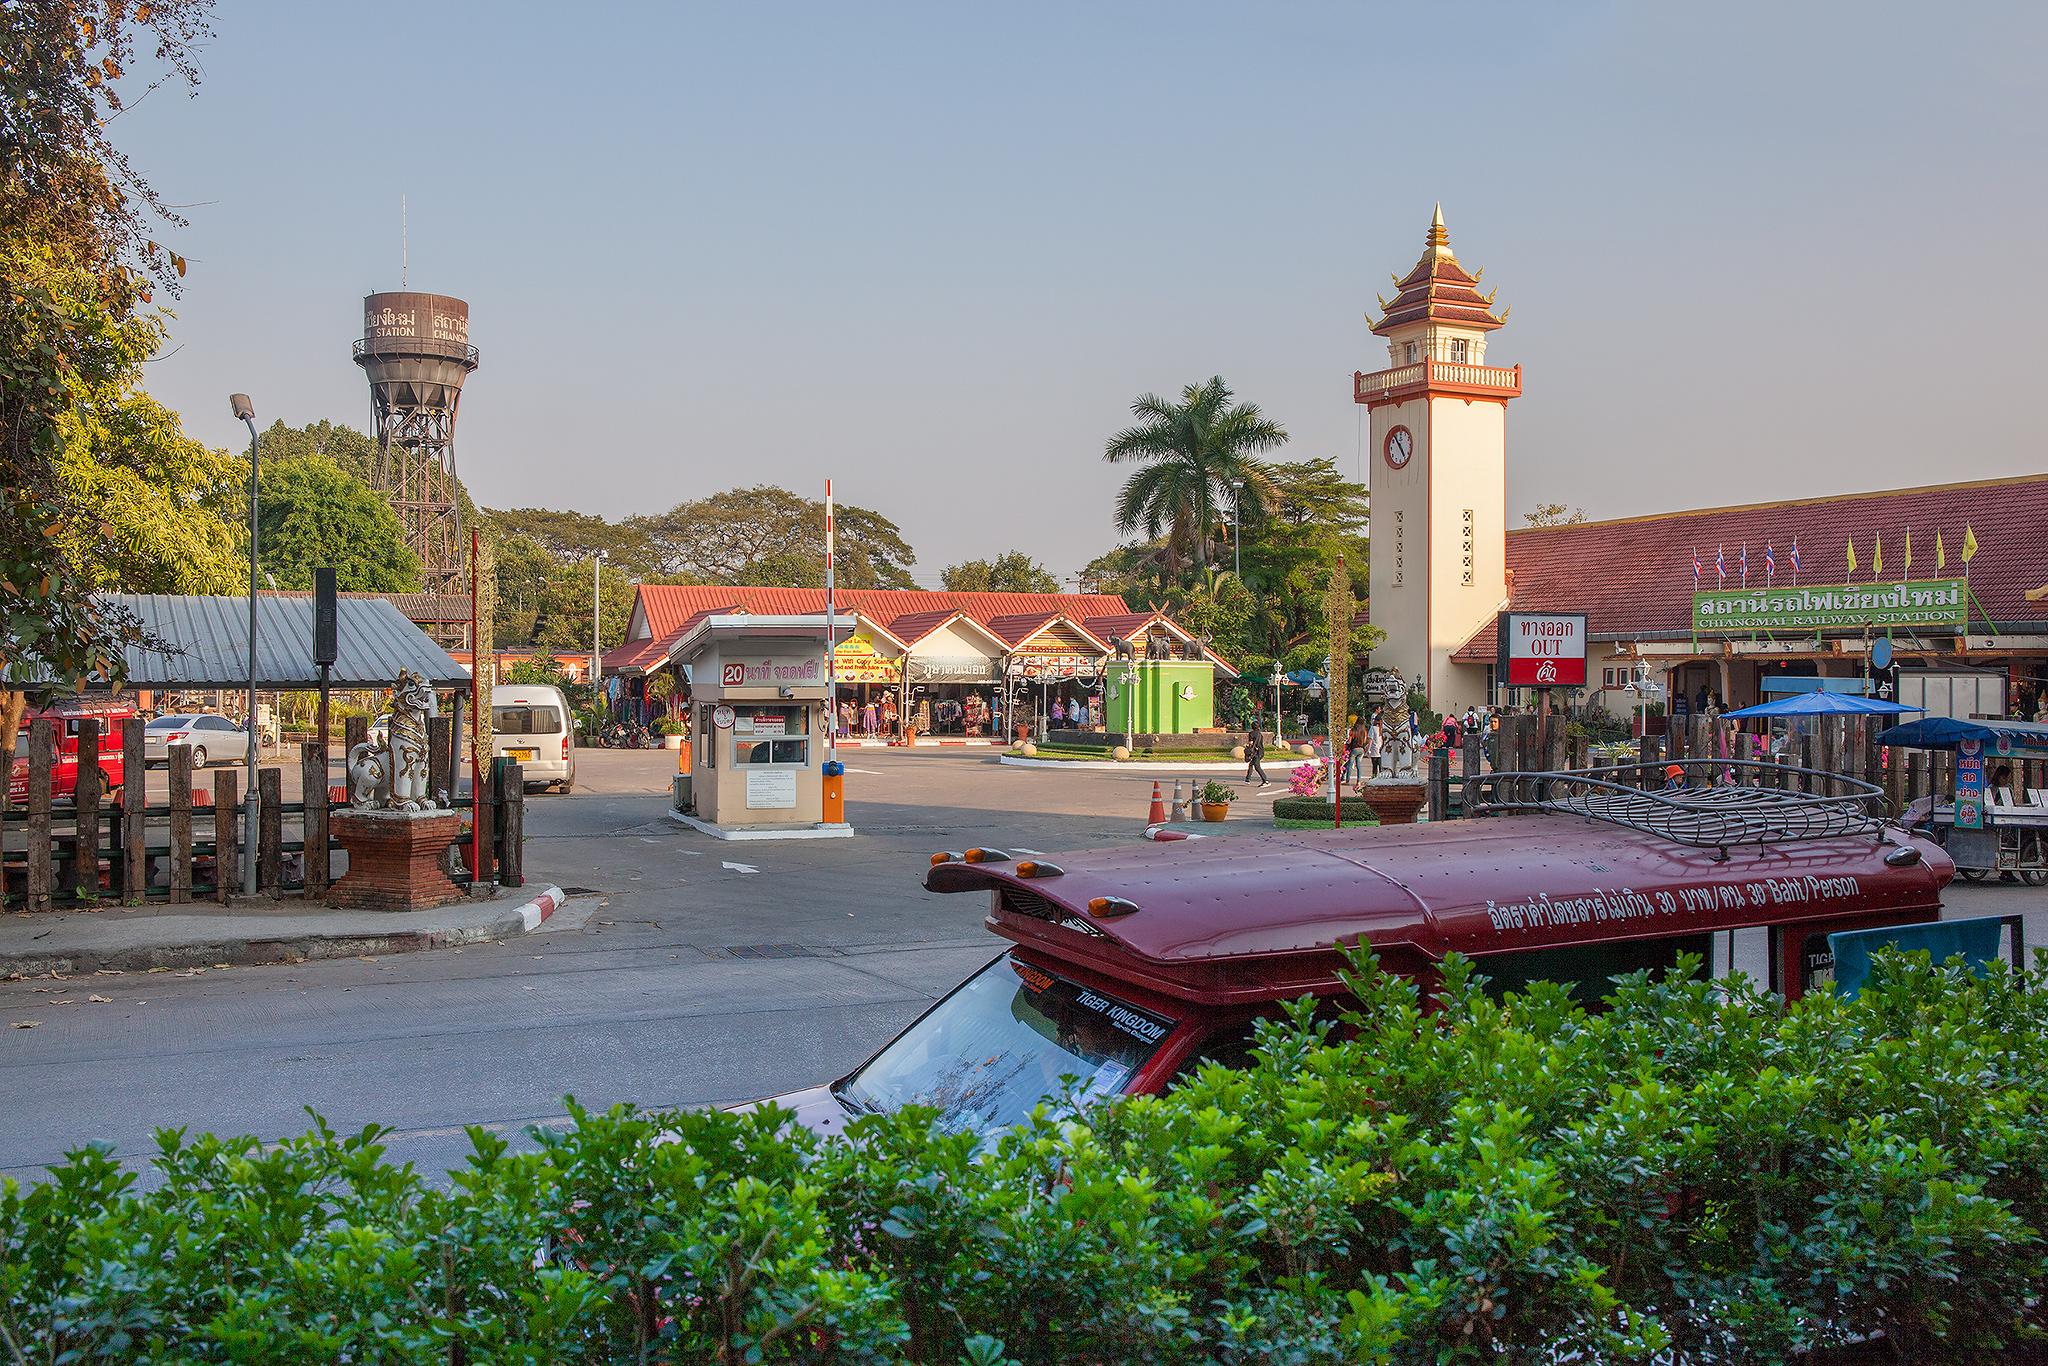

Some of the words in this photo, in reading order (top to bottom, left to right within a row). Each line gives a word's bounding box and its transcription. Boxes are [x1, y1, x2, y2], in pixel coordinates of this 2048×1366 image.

[377, 327, 414, 337] STATION
[1700, 582, 1958, 615] สถานีรถไฟเชียงใหม่
[1699, 616, 1786, 628] CHIANGMAI
[1792, 613, 1869, 625] RAILWAY
[1877, 610, 1957, 622] STATION
[1520, 621, 1573, 636] ทางออก
[1531, 639, 1562, 655] OUT
[724, 665, 743, 683] 20
[1962, 773, 1976, 782] สด
[1656, 891, 1677, 914] 30
[1679, 886, 1745, 911] บาท/คน
[1766, 875, 1860, 904] Baht/Person
[1075, 990, 1110, 1013] TIGER
[1106, 1005, 1166, 1040] KINGDOM
